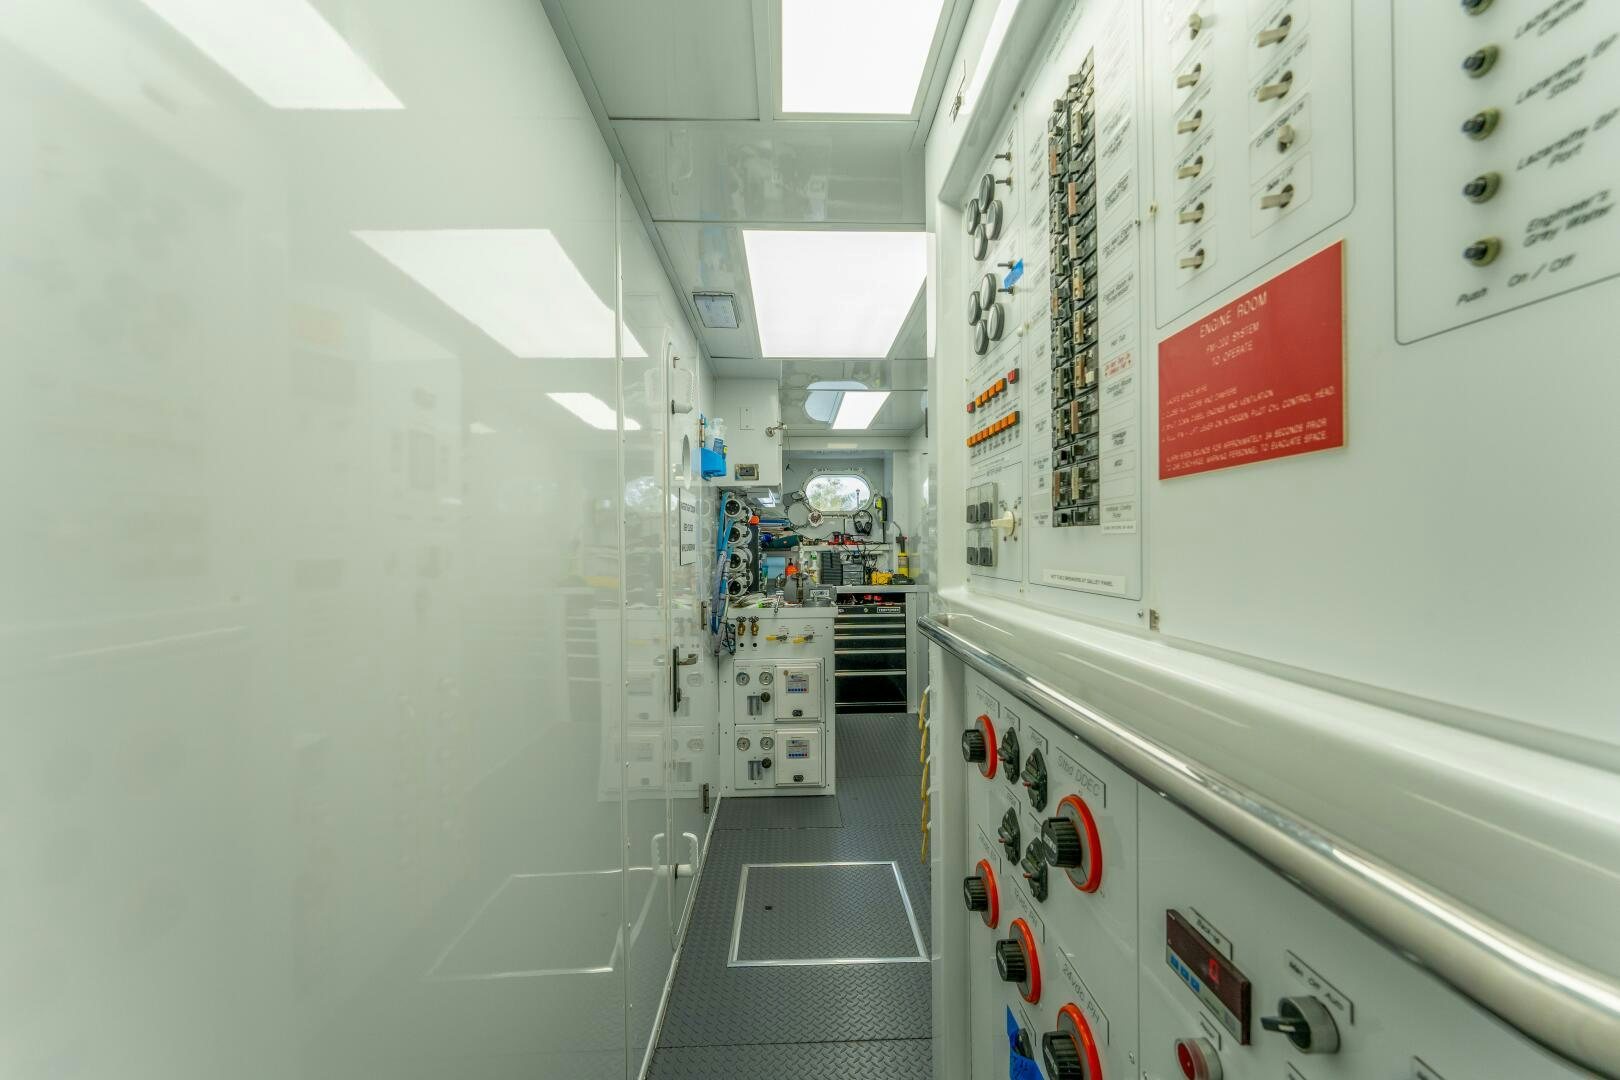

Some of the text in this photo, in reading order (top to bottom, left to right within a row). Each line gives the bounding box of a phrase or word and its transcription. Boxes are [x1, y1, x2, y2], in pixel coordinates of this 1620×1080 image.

[1507, 272, 1530, 288] On
[1548, 253, 1576, 273] Off
[1199, 291, 1267, 338] ENGINE ROOM
[1232, 322, 1260, 342] SYSTEM
[1222, 341, 1254, 363] OPERATE
[1282, 393, 1313, 409] CONTROL
